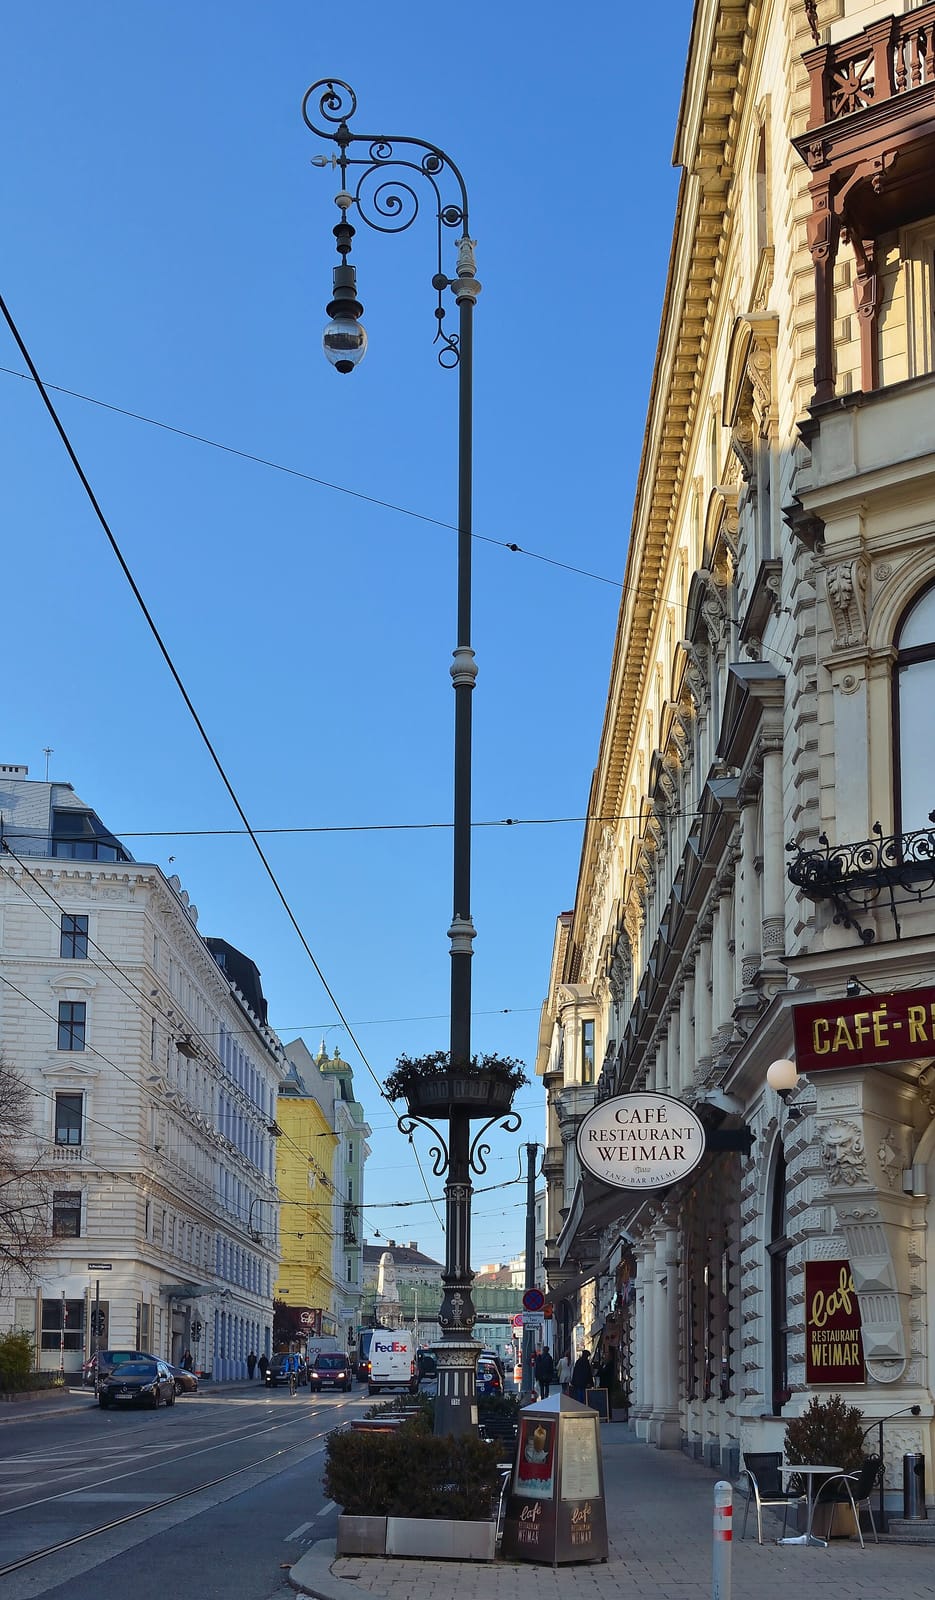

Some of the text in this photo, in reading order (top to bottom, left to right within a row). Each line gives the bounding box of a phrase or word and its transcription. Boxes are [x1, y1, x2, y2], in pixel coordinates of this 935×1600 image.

[615, 1105, 668, 1124] CAFÉ
[588, 1128, 695, 1142] RESTAURANT
[596, 1145, 687, 1162] WEIMAR
[811, 1329, 859, 1342] RESTAURANT
[375, 1342, 407, 1353] FedEx
[811, 1343, 860, 1366] WEIMAR
